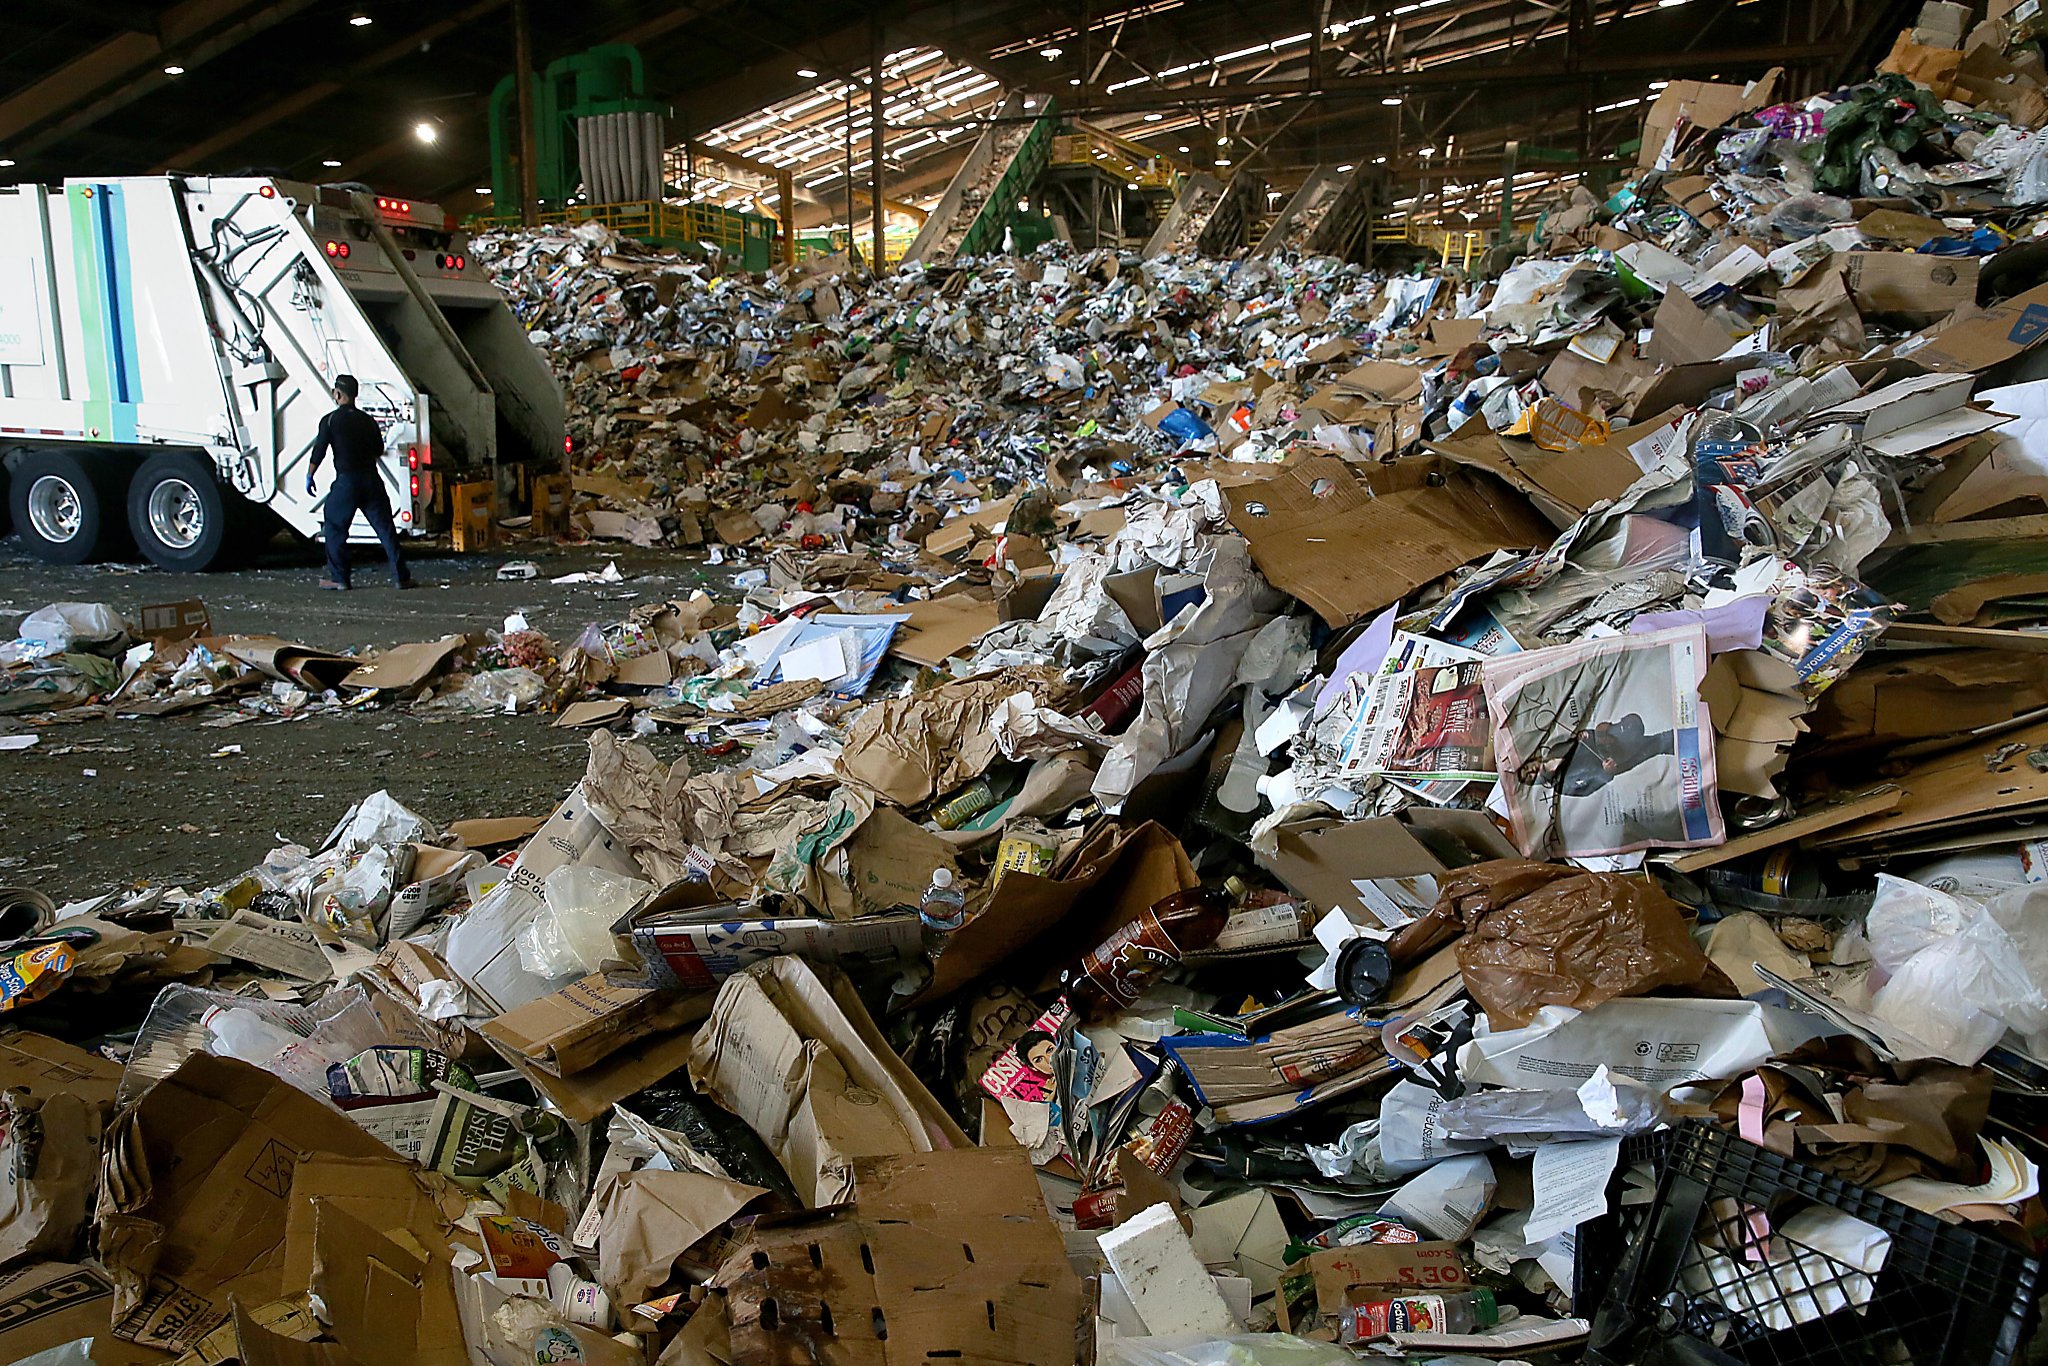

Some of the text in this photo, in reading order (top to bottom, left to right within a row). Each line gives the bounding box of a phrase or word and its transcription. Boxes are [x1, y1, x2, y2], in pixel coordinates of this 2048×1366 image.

[1805, 650, 1828, 674] your
[1823, 615, 1862, 654] summer
[1398, 679, 1408, 700] SAVE
[1444, 699, 1459, 733] BRITTLE
[1454, 698, 1469, 733] BROWNIE
[1384, 728, 1395, 748] SAVE
[1681, 757, 1699, 810] WAITRESS
[426, 1053, 436, 1069] UP.
[491, 1176, 504, 1189] pm
[1399, 1231, 1413, 1240] OFF
